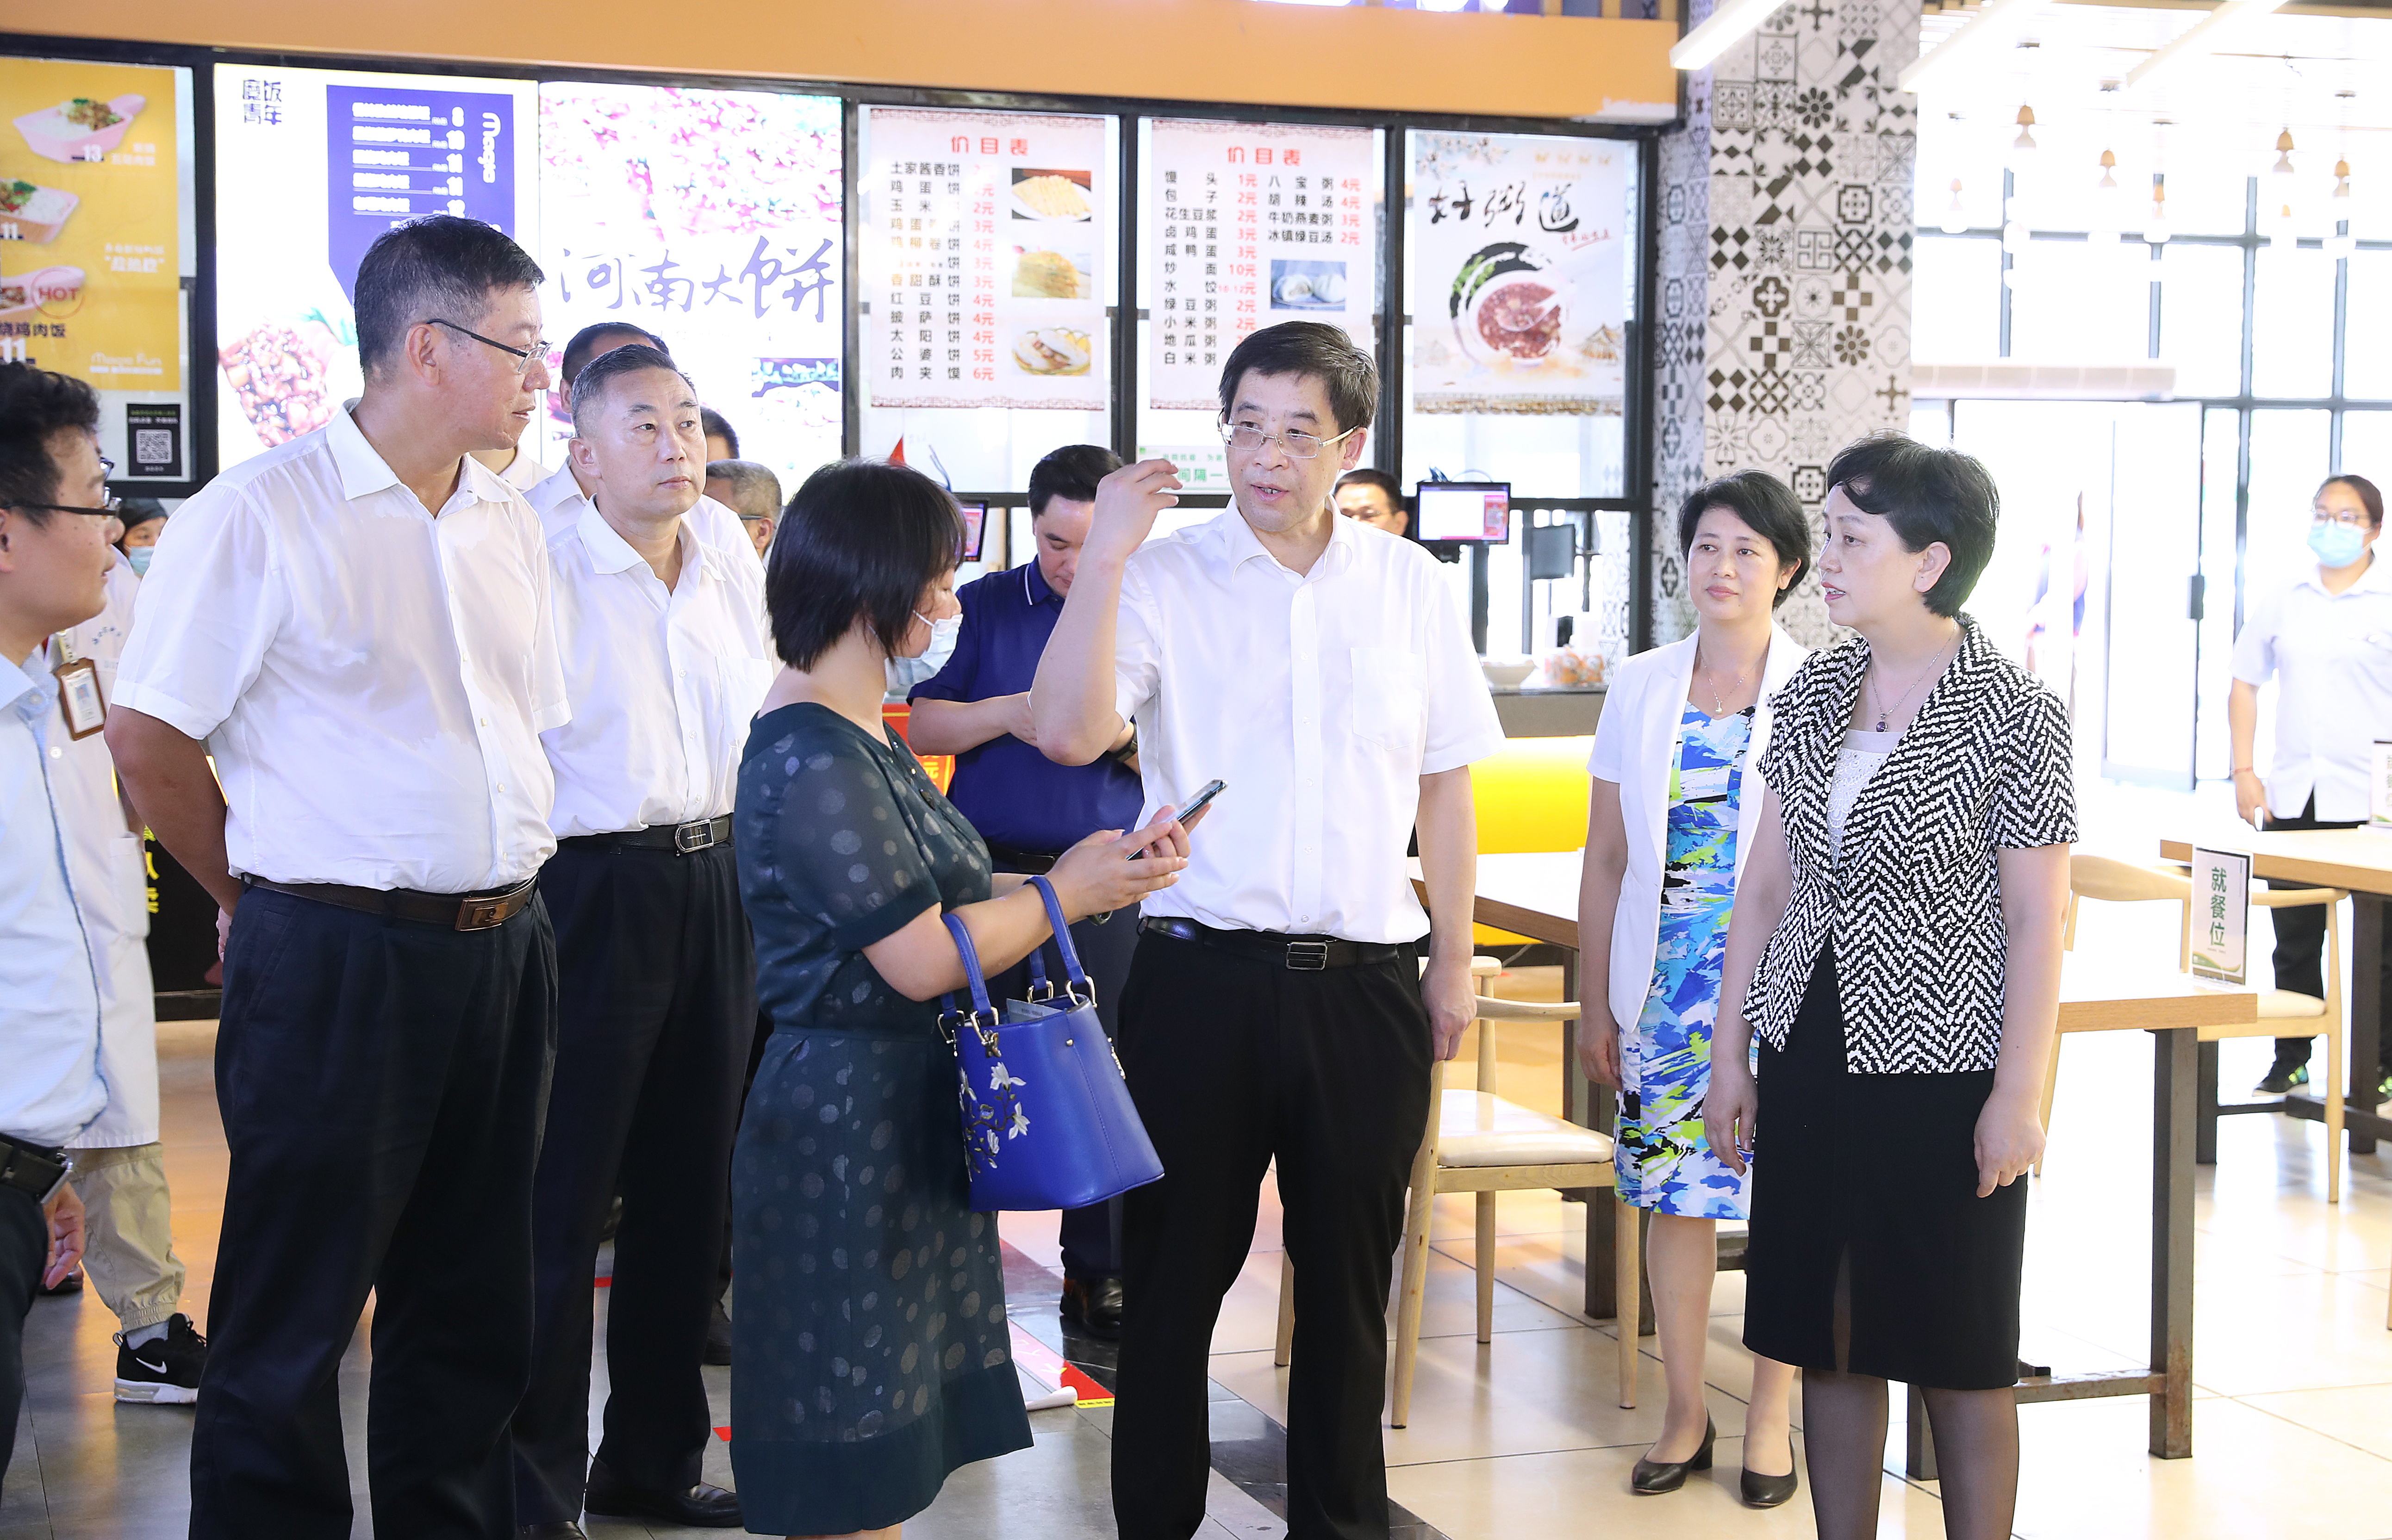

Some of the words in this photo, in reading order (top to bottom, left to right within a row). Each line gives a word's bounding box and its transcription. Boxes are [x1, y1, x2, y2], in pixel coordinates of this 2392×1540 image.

[951, 136, 1028, 155] 价目表
[1227, 147, 1300, 166] 价目表
[891, 162, 959, 176] 土家酱香饼
[1165, 171, 1216, 185] 馒头
[1239, 174, 1258, 187] 1元
[1269, 176, 1333, 190] 八宝粥
[1341, 179, 1360, 192] 4元
[891, 180, 959, 194] 鸡蛋饼
[1165, 189, 1216, 203] 包子
[1238, 192, 1257, 205] 2元
[1269, 193, 1333, 208] 胡辣汤
[1341, 196, 1361, 210] 4元
[891, 198, 960, 214] 玉米
[974, 202, 994, 215] 2元
[1428, 180, 1579, 232] 好粥道
[1165, 207, 1217, 221] 花生豆浆
[1238, 210, 1257, 223] 2元
[1269, 211, 1332, 225] 牛奶燕麦粥
[1342, 214, 1360, 227] 3元
[975, 220, 994, 234] 3元
[1165, 225, 1216, 239] 卤鸡蛋
[1239, 228, 1257, 241] 3元
[1269, 230, 1332, 243] 冰镇绿豆汤
[1341, 232, 1359, 245] 2元
[973, 239, 993, 252] 4元
[1165, 243, 1216, 257] 咸鸭蛋
[1238, 246, 1257, 259] 3元
[974, 257, 994, 271] 3元
[1165, 262, 1216, 275] 炒面
[1230, 264, 1256, 277] 10元
[561, 235, 835, 323] 河南大饼
[974, 276, 994, 289] 3元
[1165, 280, 1216, 293] 水饺
[38, 287, 80, 301] HOT
[891, 292, 960, 306] 红豆饼
[973, 294, 994, 307] 4元
[1165, 298, 1217, 311] 绿豆粥
[1237, 300, 1256, 313] 2元
[891, 311, 960, 325] 披萨饼
[973, 313, 994, 326] 4元
[1165, 316, 1216, 329] 小米粥
[1237, 317, 1256, 330] 2元
[891, 329, 960, 343] 太阳饼
[973, 331, 994, 344] 4元
[1165, 334, 1216, 347] 地瓜粥
[891, 348, 959, 361] 公婆饼
[974, 349, 994, 362] 5元
[1165, 352, 1216, 365] 白米粥
[891, 366, 959, 379] 肉夹馍
[973, 367, 994, 381] 6元
[2210, 866, 2227, 947] 就餐位
